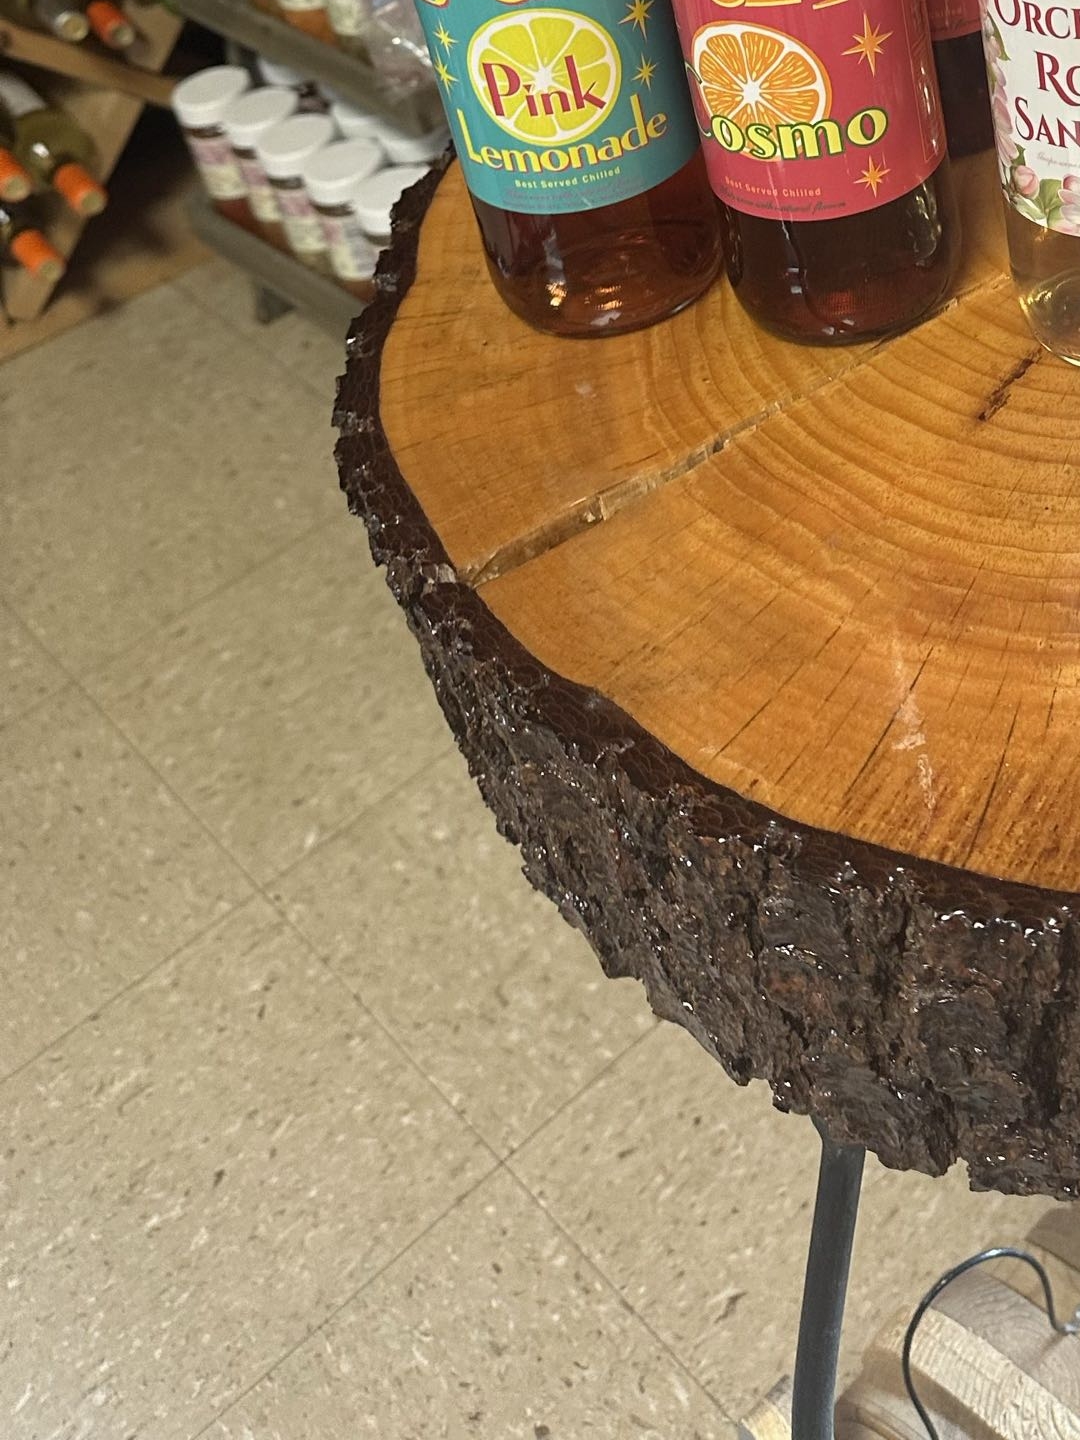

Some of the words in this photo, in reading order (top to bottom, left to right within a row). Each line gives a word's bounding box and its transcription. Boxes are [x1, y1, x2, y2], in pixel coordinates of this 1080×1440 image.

[482, 55, 606, 119] Pink
[456, 95, 668, 174] Lemonade
[514, 179, 537, 190] Best
[541, 178, 577, 189] Served
[582, 166, 621, 184] Chilled
[725, 175, 743, 190] Best
[783, 187, 822, 198] Chilled
